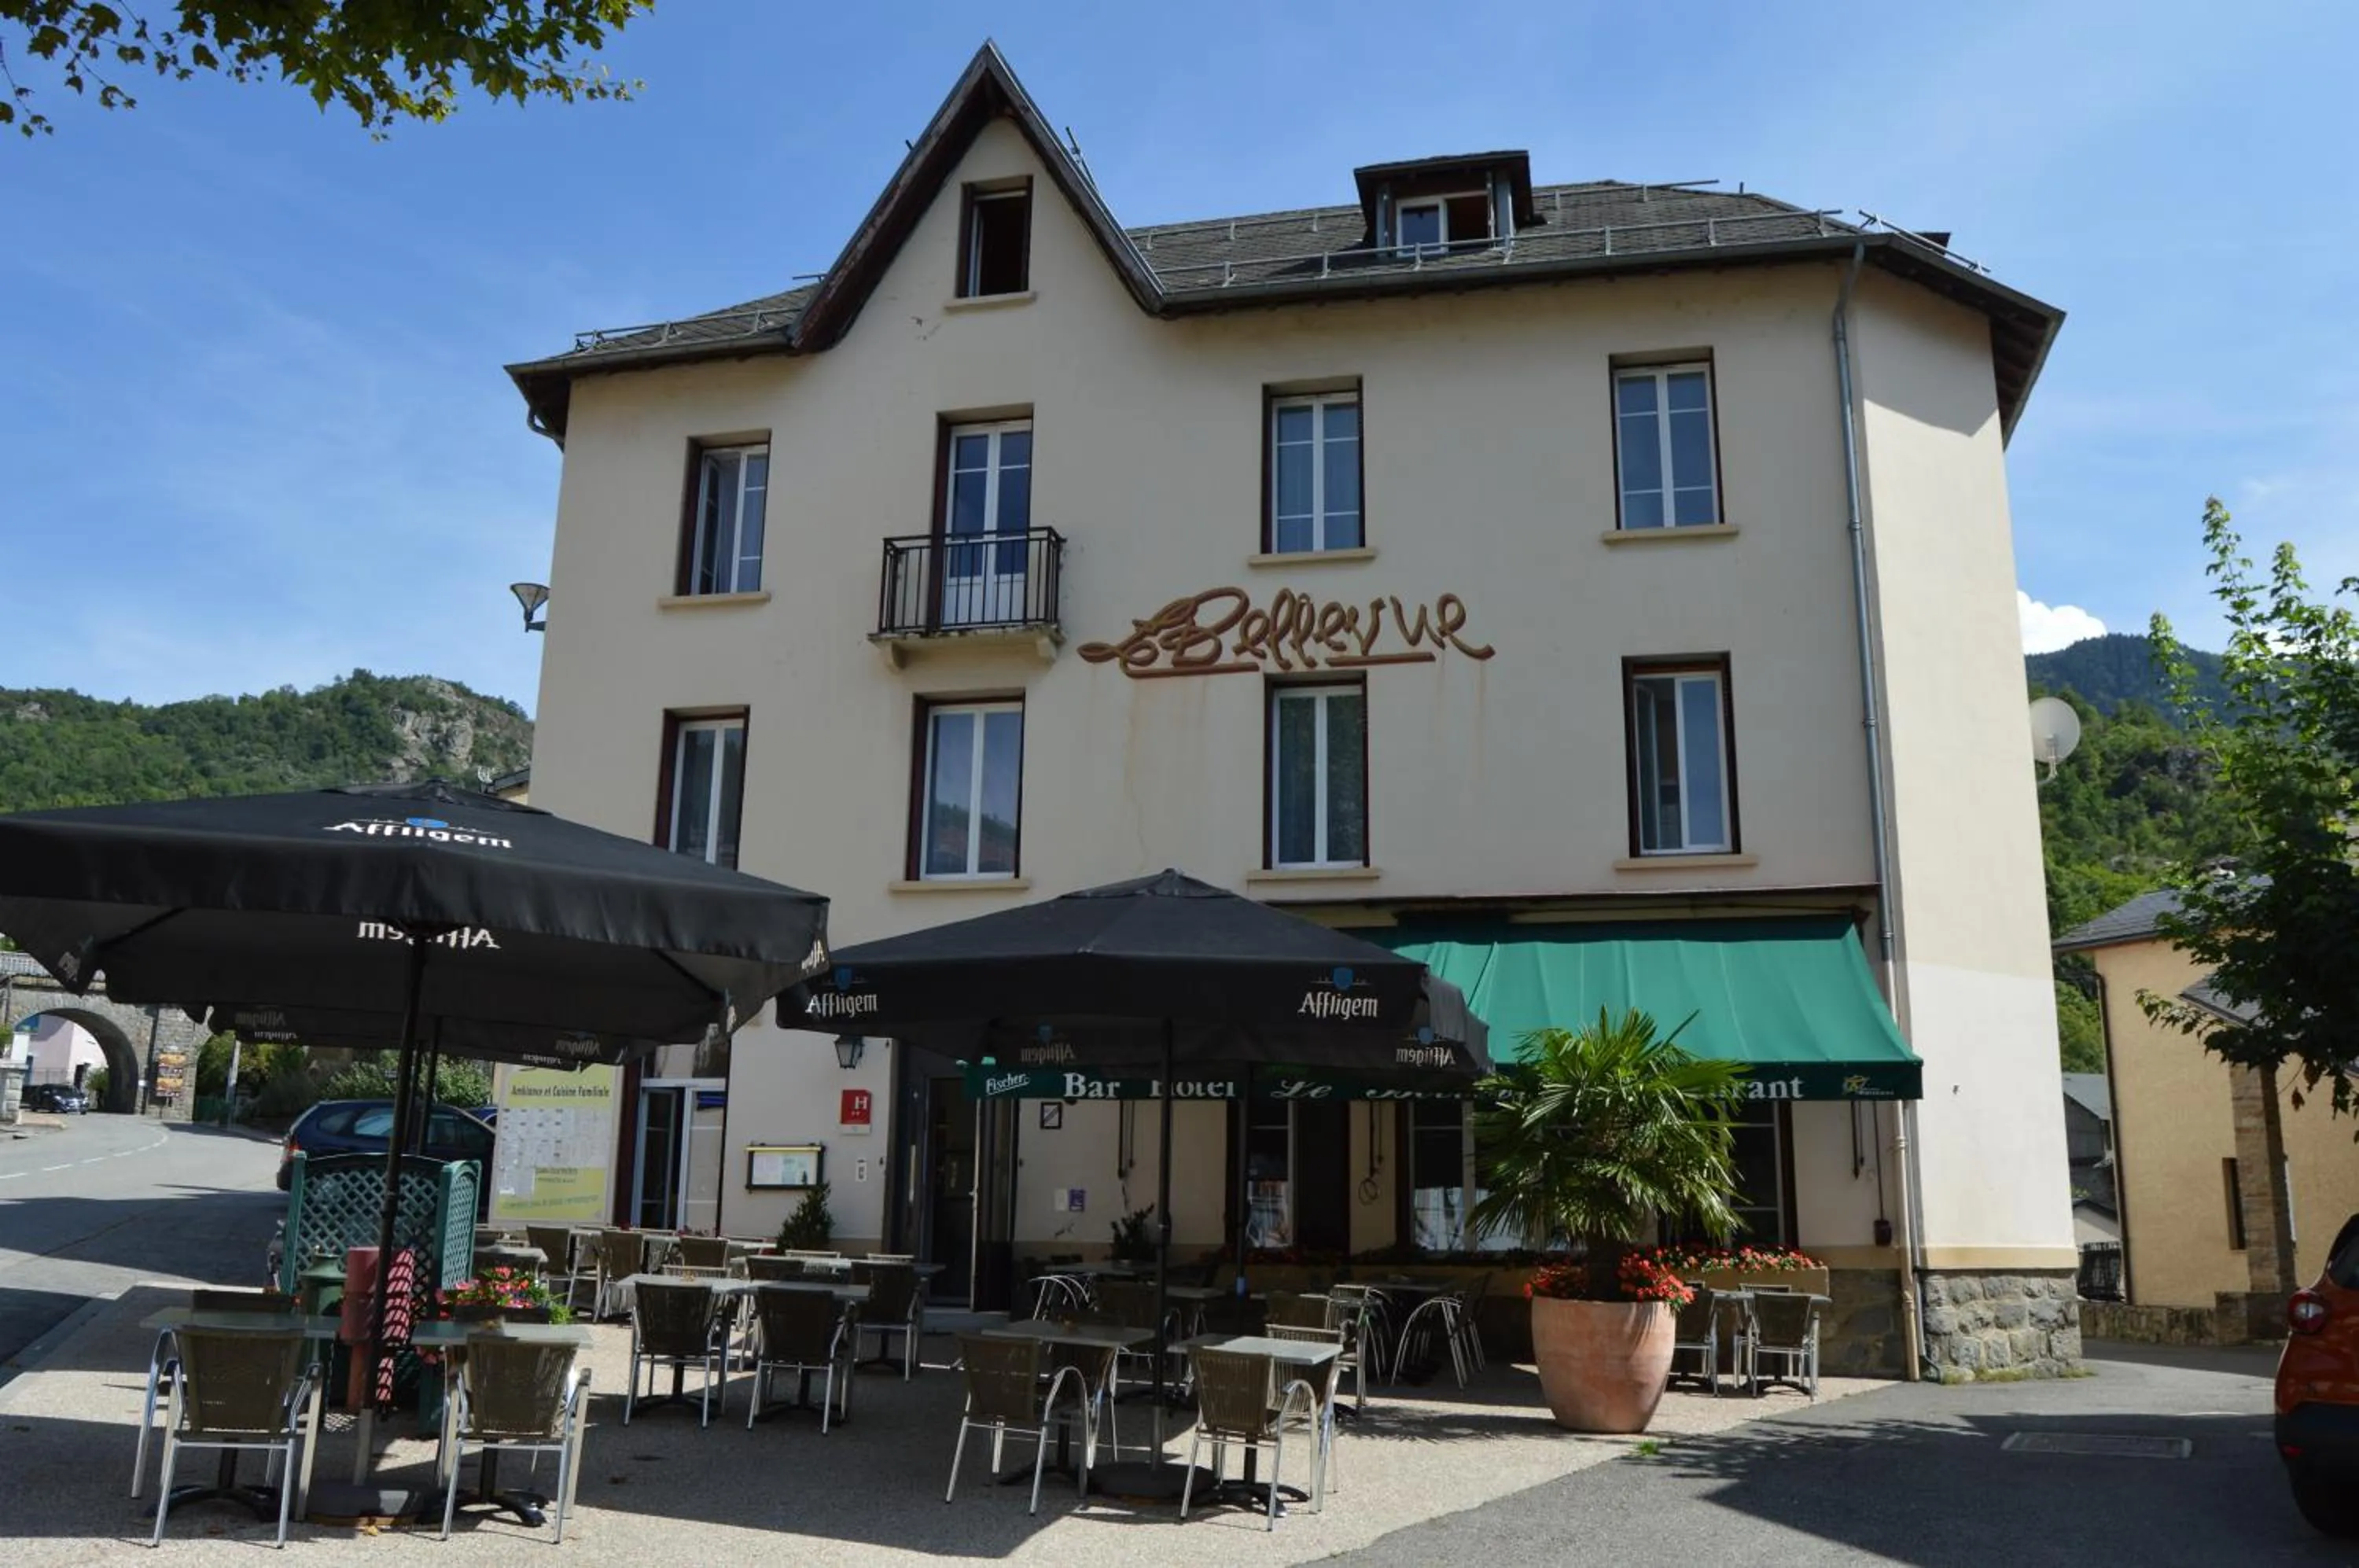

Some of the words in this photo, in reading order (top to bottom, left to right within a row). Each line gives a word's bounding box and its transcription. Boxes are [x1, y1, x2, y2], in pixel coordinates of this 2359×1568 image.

[323, 821, 513, 848] Affligem
[805, 991, 878, 1018] Affligem
[1297, 990, 1378, 1020] Affligem
[1064, 1072, 1121, 1098] Bar
[855, 1096, 867, 1110] H
